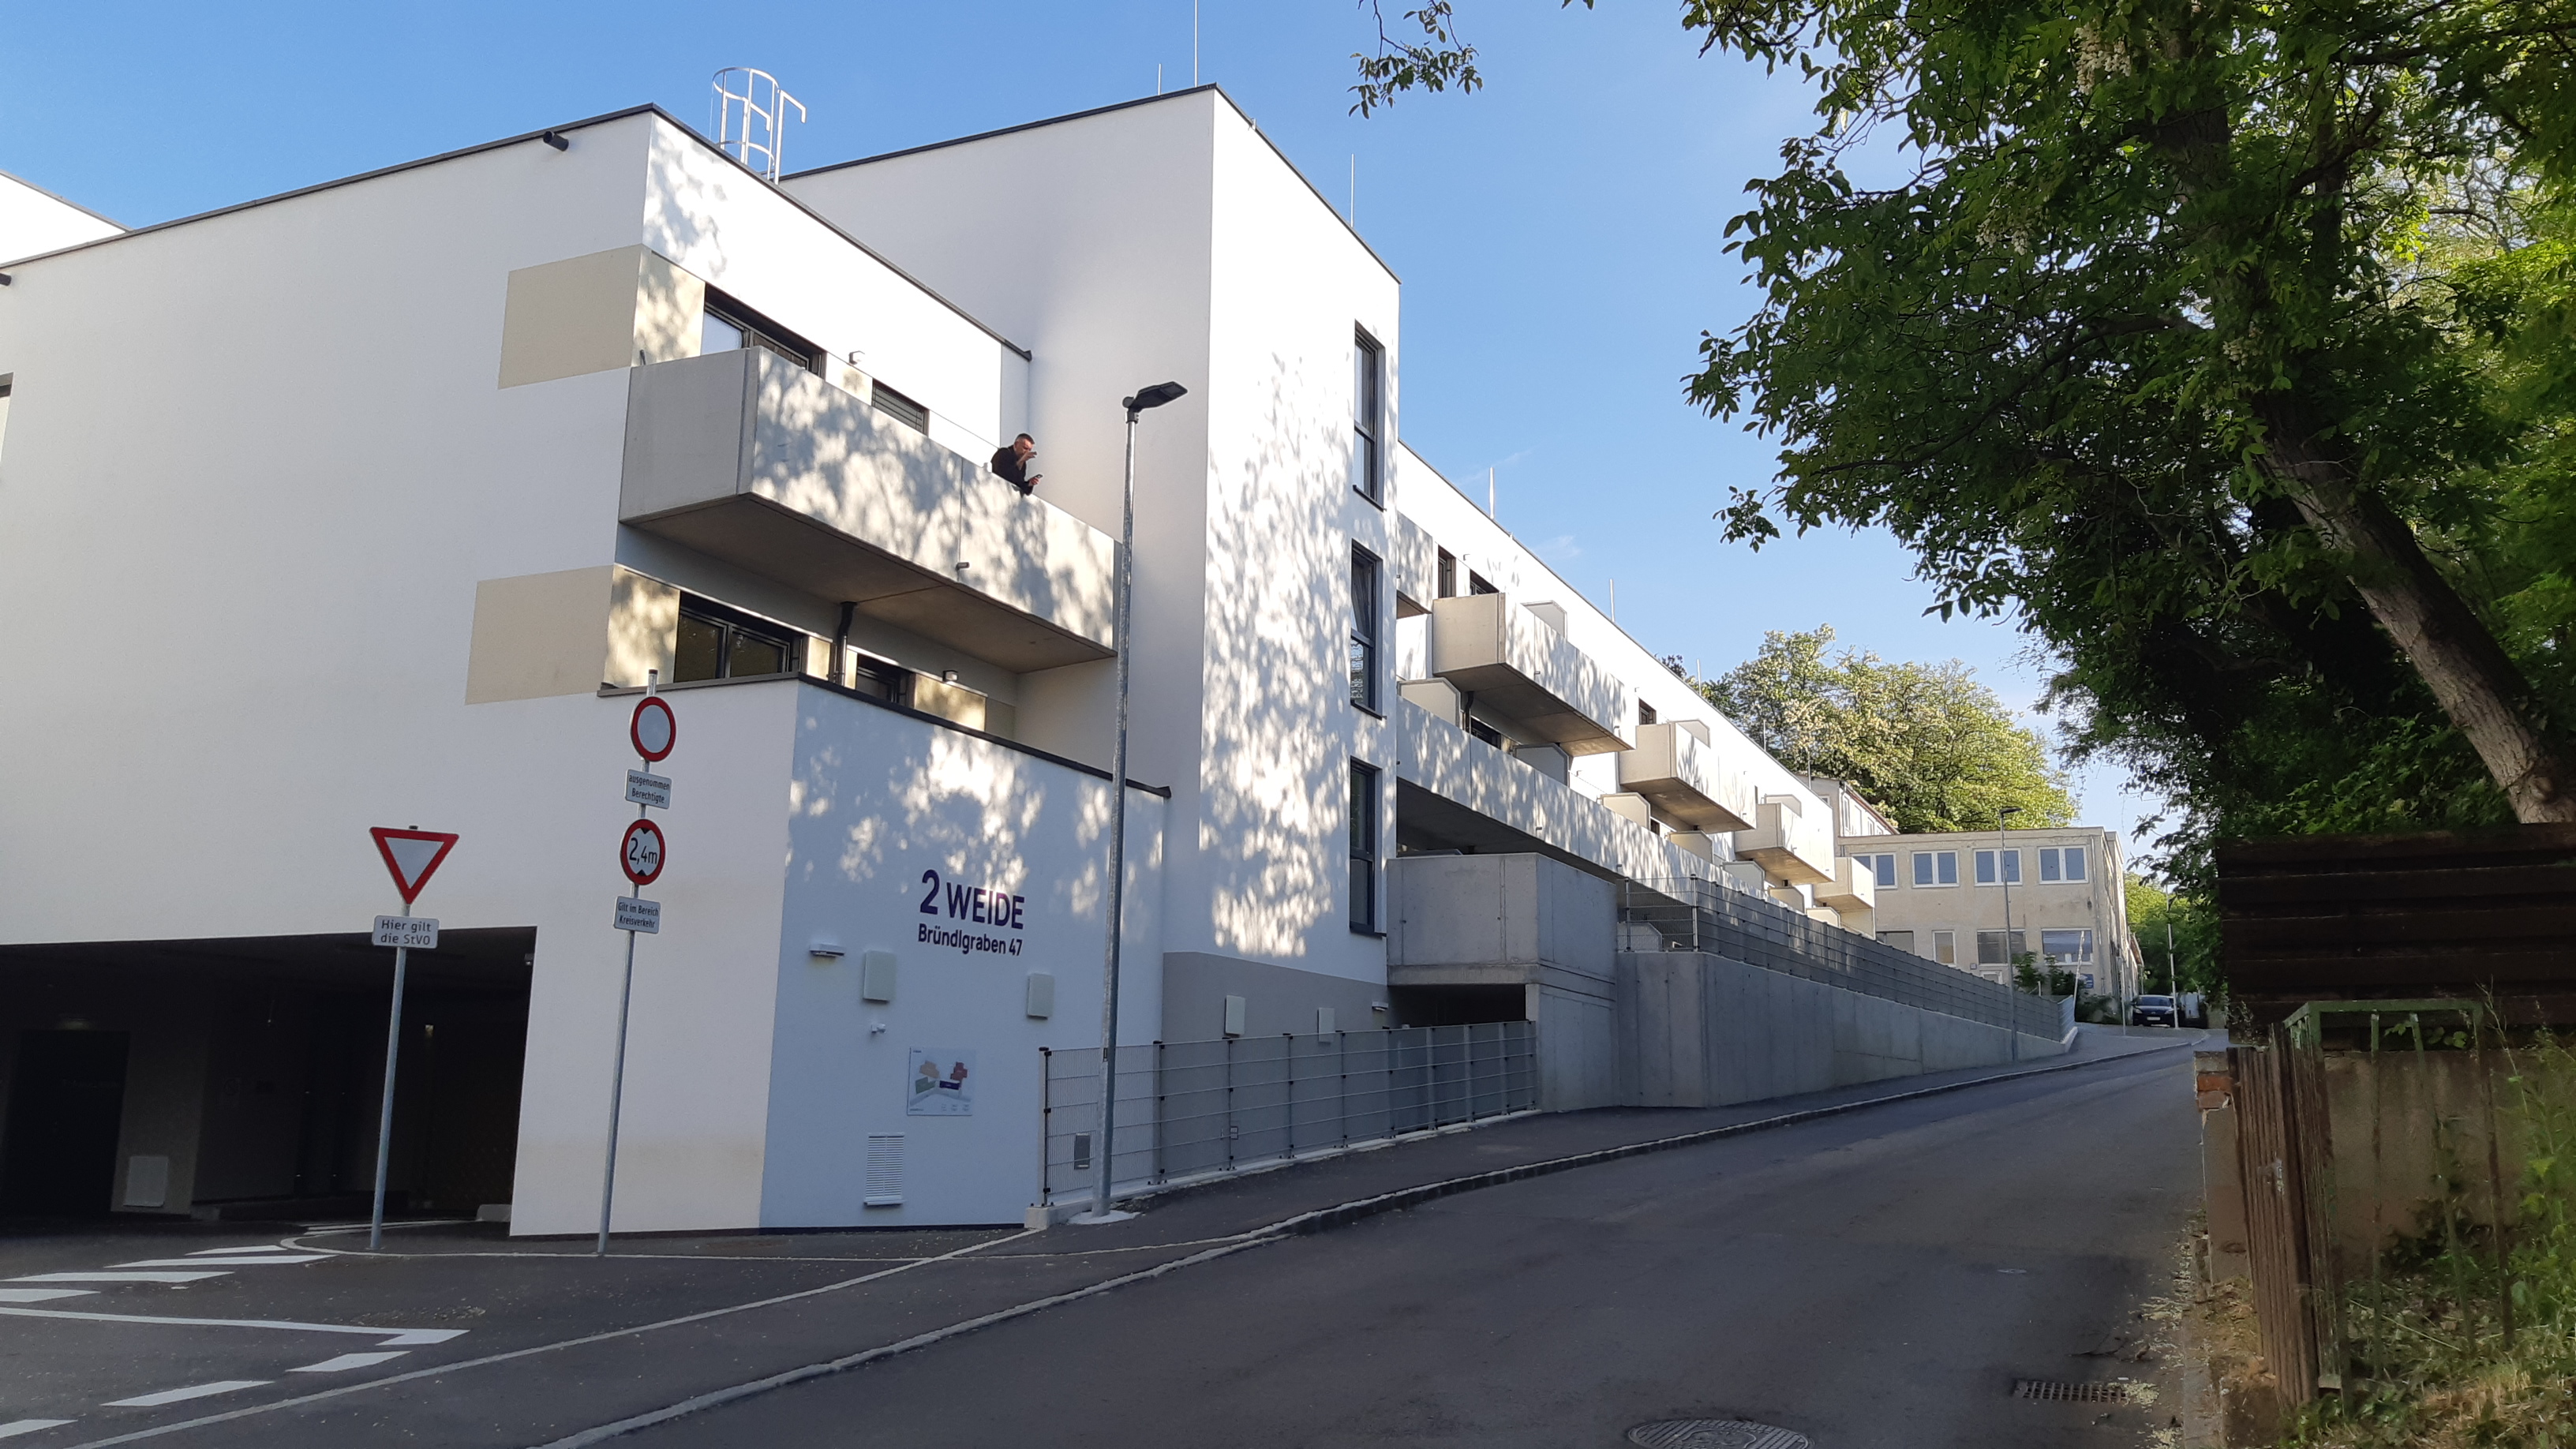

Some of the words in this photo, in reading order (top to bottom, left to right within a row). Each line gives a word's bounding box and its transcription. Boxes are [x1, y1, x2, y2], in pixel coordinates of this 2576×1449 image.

[628, 774, 670, 791] ausgenommen
[631, 788, 665, 804] Berechtigte
[629, 837, 658, 865] 2,4m
[919, 869, 940, 915] 2
[946, 882, 1025, 930] WEIDE
[618, 902, 629, 912] Gilt
[630, 903, 637, 913] im
[638, 904, 659, 916] Bereich
[381, 919, 406, 930] Hier
[411, 921, 432, 933] gilt
[620, 915, 655, 928] Kreisverkehr
[380, 933, 399, 943] die
[403, 934, 431, 945] StVO
[918, 923, 1006, 955] Bründlgraben
[1009, 938, 1023, 957] 47
